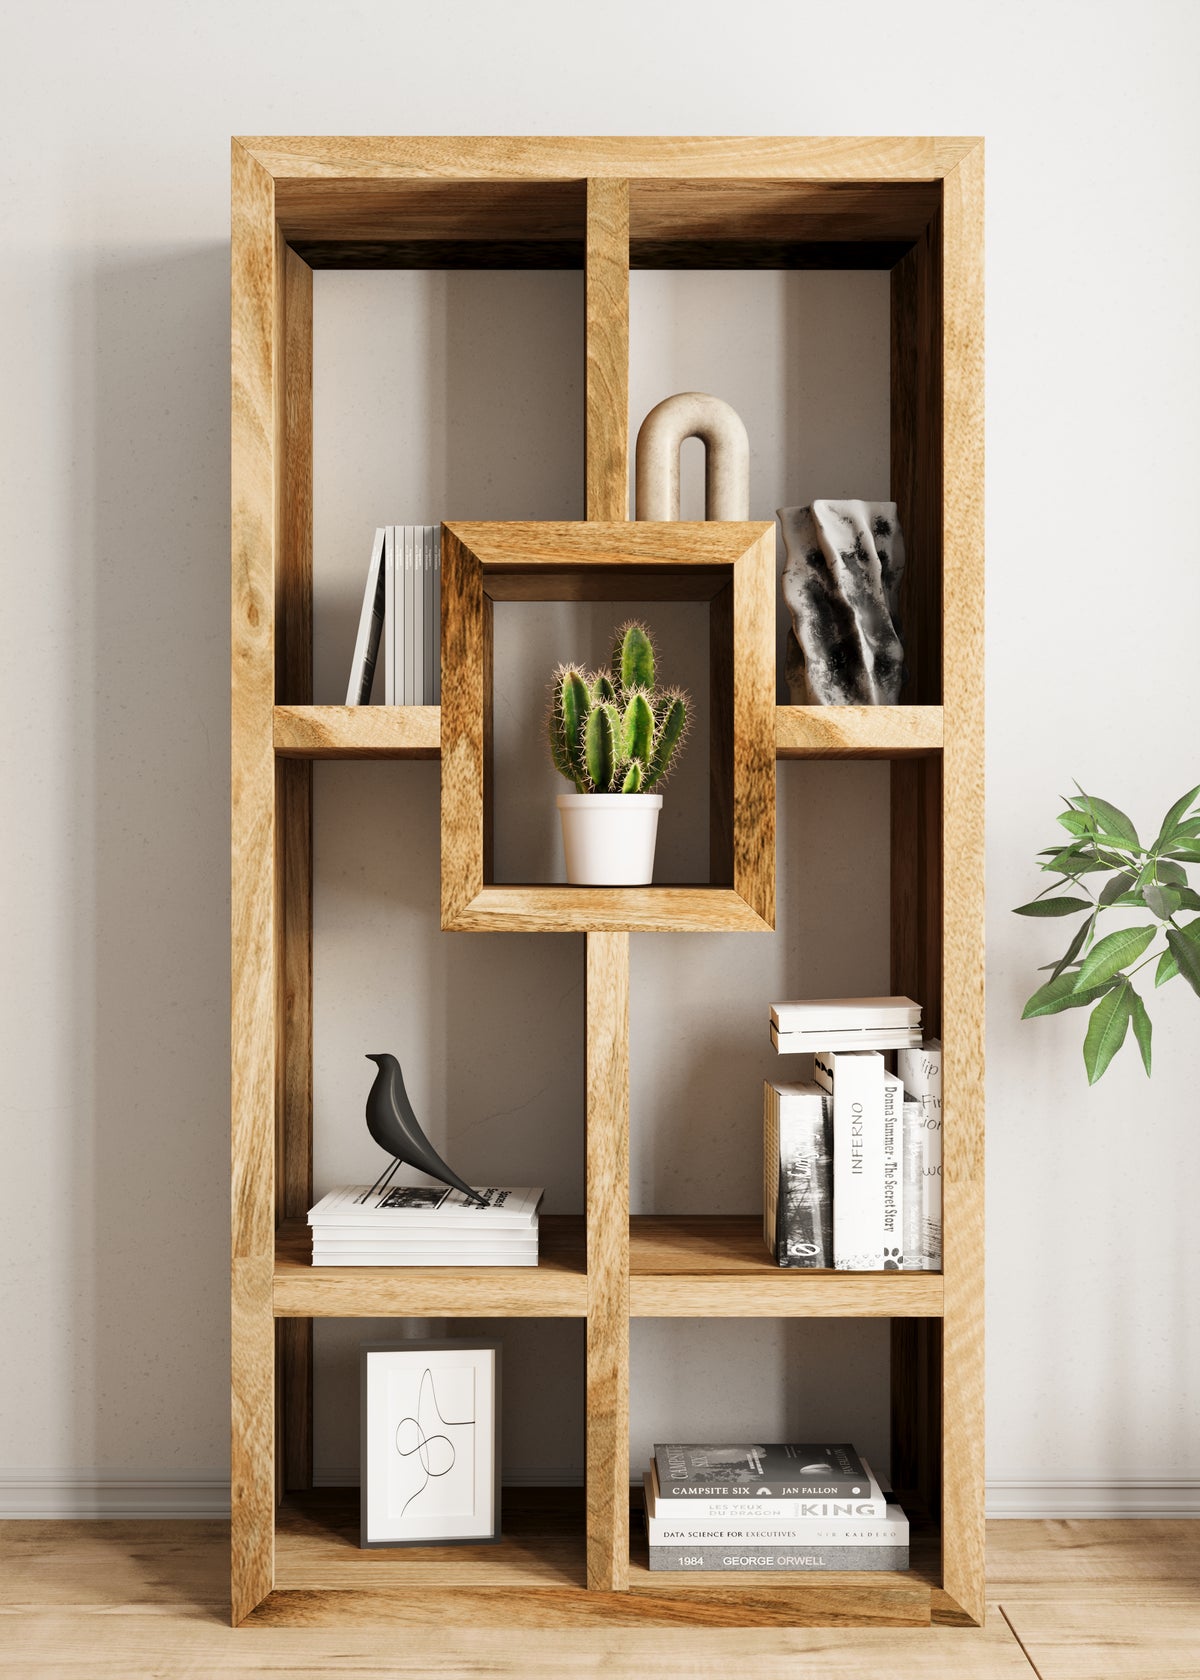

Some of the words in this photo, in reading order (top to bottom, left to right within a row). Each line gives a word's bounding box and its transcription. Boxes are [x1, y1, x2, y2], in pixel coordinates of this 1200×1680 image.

[884, 1086, 898, 1116] Donna
[851, 1102, 864, 1175] INFERNO
[884, 1117, 898, 1155] Summer
[884, 1161, 898, 1179] The
[884, 1179, 898, 1209] Secret
[883, 1208, 898, 1233] Story
[672, 1487, 729, 1495] CAMPSITE
[732, 1487, 750, 1495] SIX
[782, 1487, 799, 1496] JAN
[801, 1487, 838, 1495] FALLON
[801, 1503, 876, 1516] KING
[678, 1556, 705, 1566] 1984
[723, 1556, 775, 1566] GEORGE
[777, 1556, 826, 1566] ORWELL
